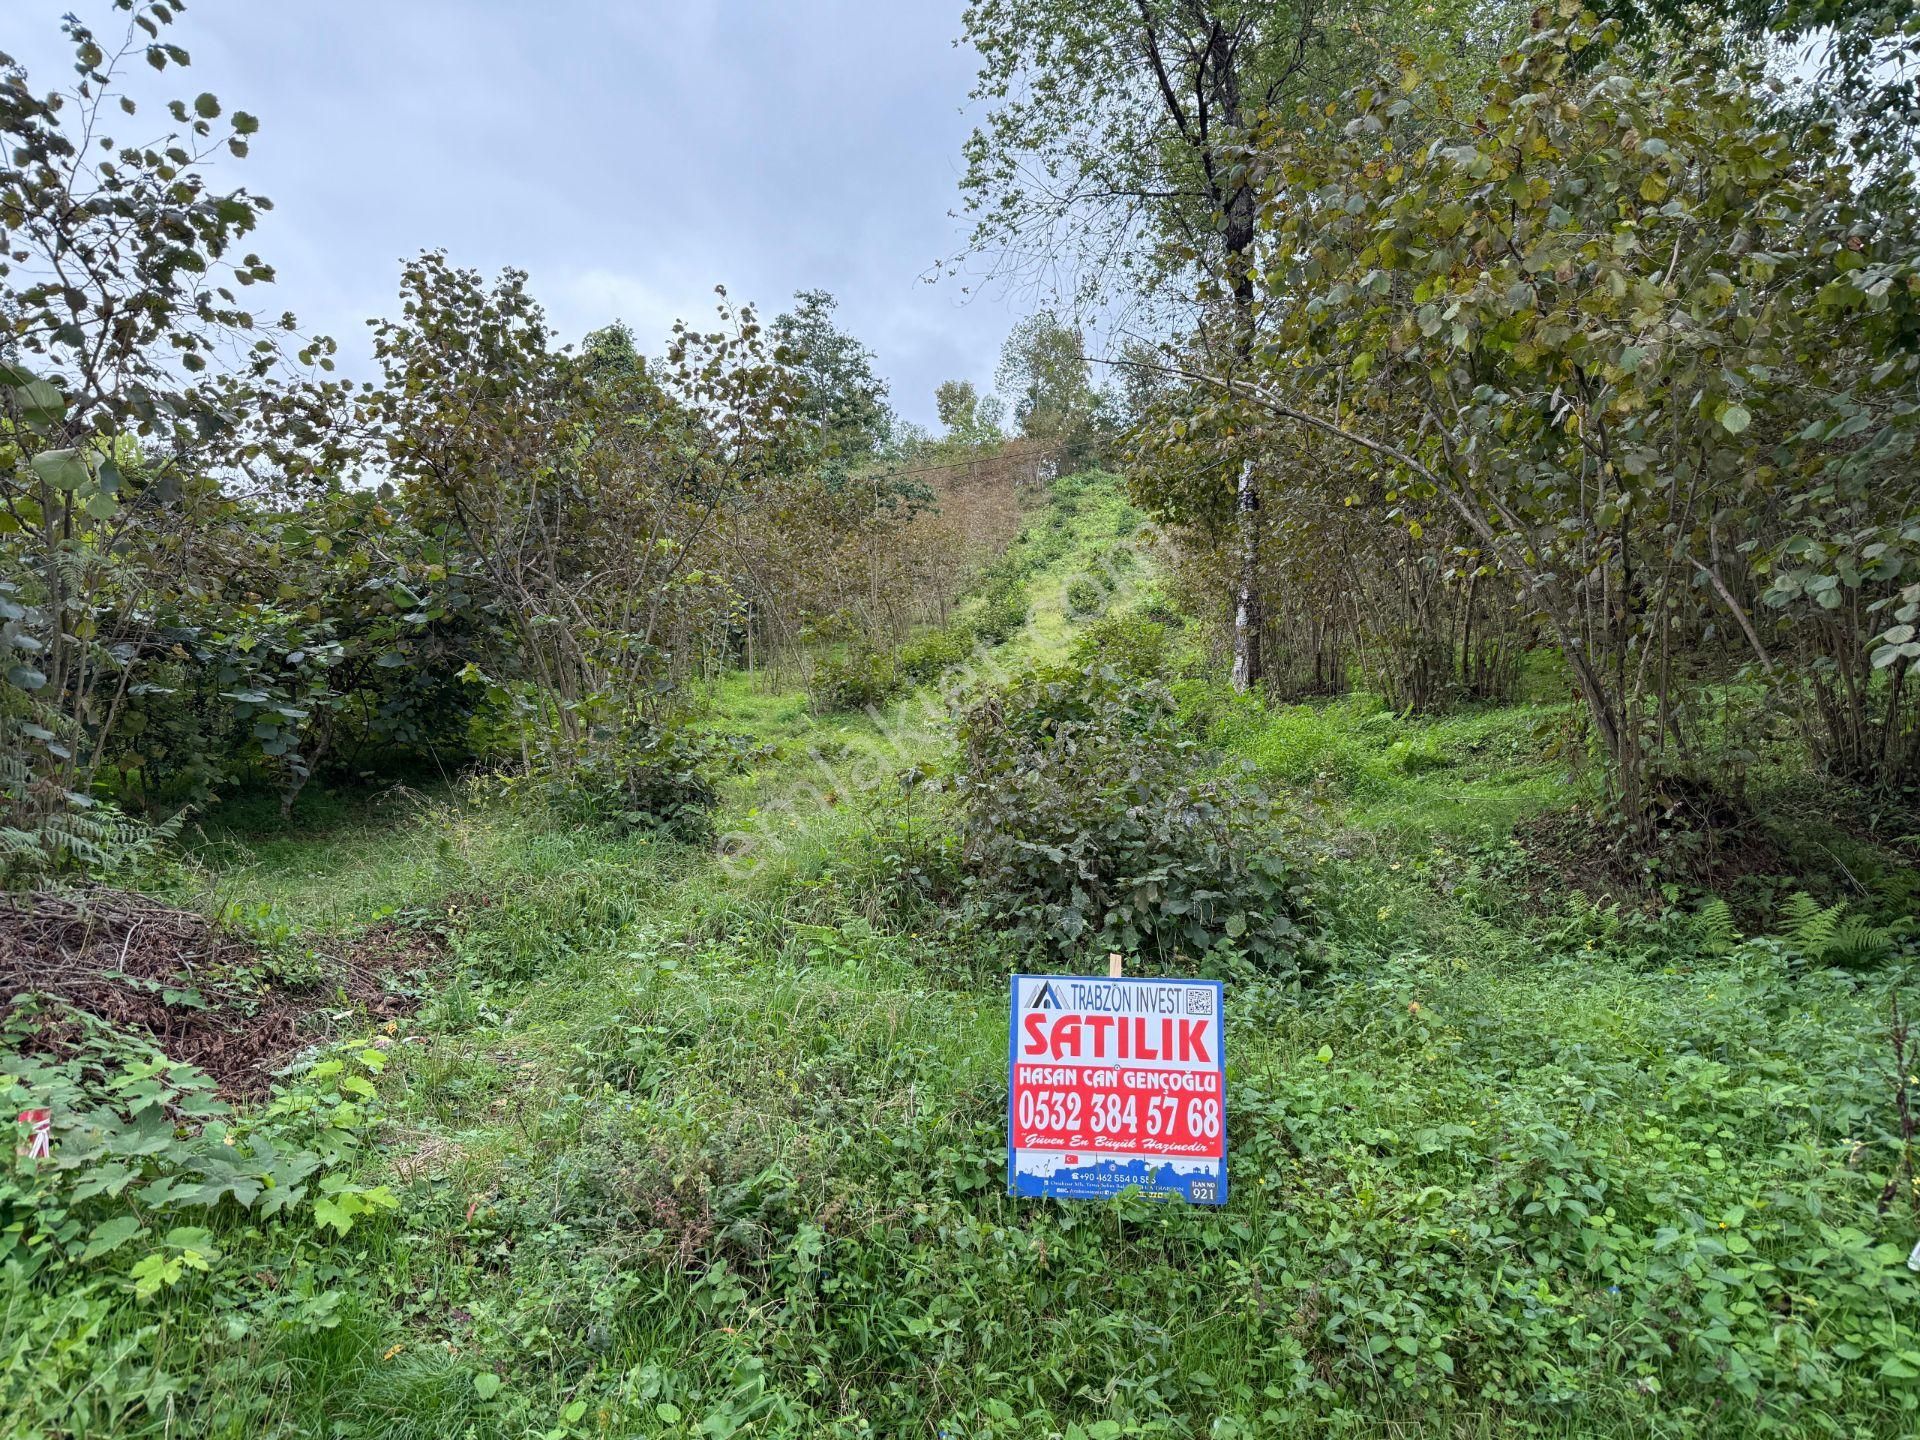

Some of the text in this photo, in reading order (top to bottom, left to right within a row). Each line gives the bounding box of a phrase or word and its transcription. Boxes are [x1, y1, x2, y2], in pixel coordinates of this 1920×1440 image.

[1071, 983, 1182, 1014] TRABZON INVEST
[1024, 1012, 1211, 1063] SATILIK
[1019, 1067, 1216, 1095] HASAN CAN GENÇOĞLU
[1019, 1090, 1220, 1138] 0532 384 57 68
[1069, 1134, 1089, 1146] En
[1095, 1136, 1137, 1151] Büyük
[1114, 1175, 1130, 1183] 554
[1193, 1188, 1214, 1200] 921
